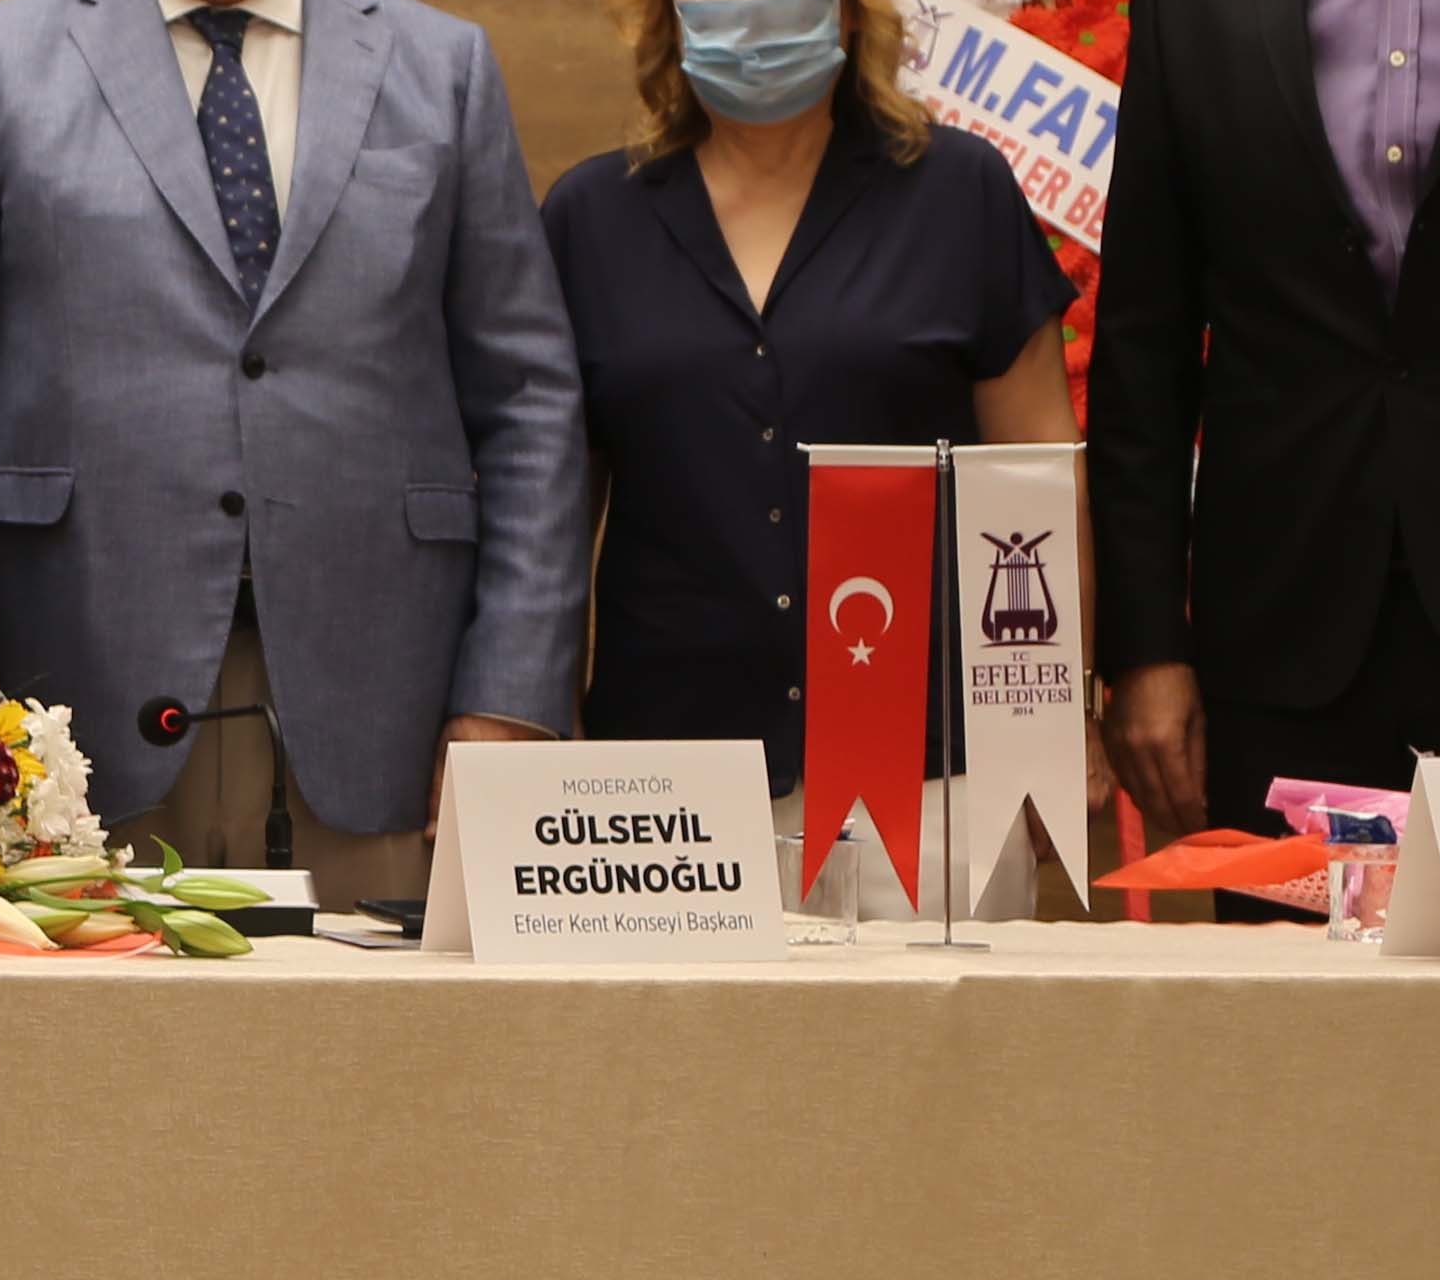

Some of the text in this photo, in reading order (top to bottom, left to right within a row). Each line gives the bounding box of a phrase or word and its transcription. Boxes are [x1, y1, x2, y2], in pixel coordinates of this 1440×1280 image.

[971, 662, 1072, 688] EFELER
[972, 686, 1073, 706] BELEDİYESİ
[561, 776, 674, 796] MODERATÖR
[534, 807, 712, 846] GÜLSEVİL
[513, 856, 743, 896] ERGÜNOĞLU
[513, 910, 755, 937] Efeler Kent Konseyi Başkanı
